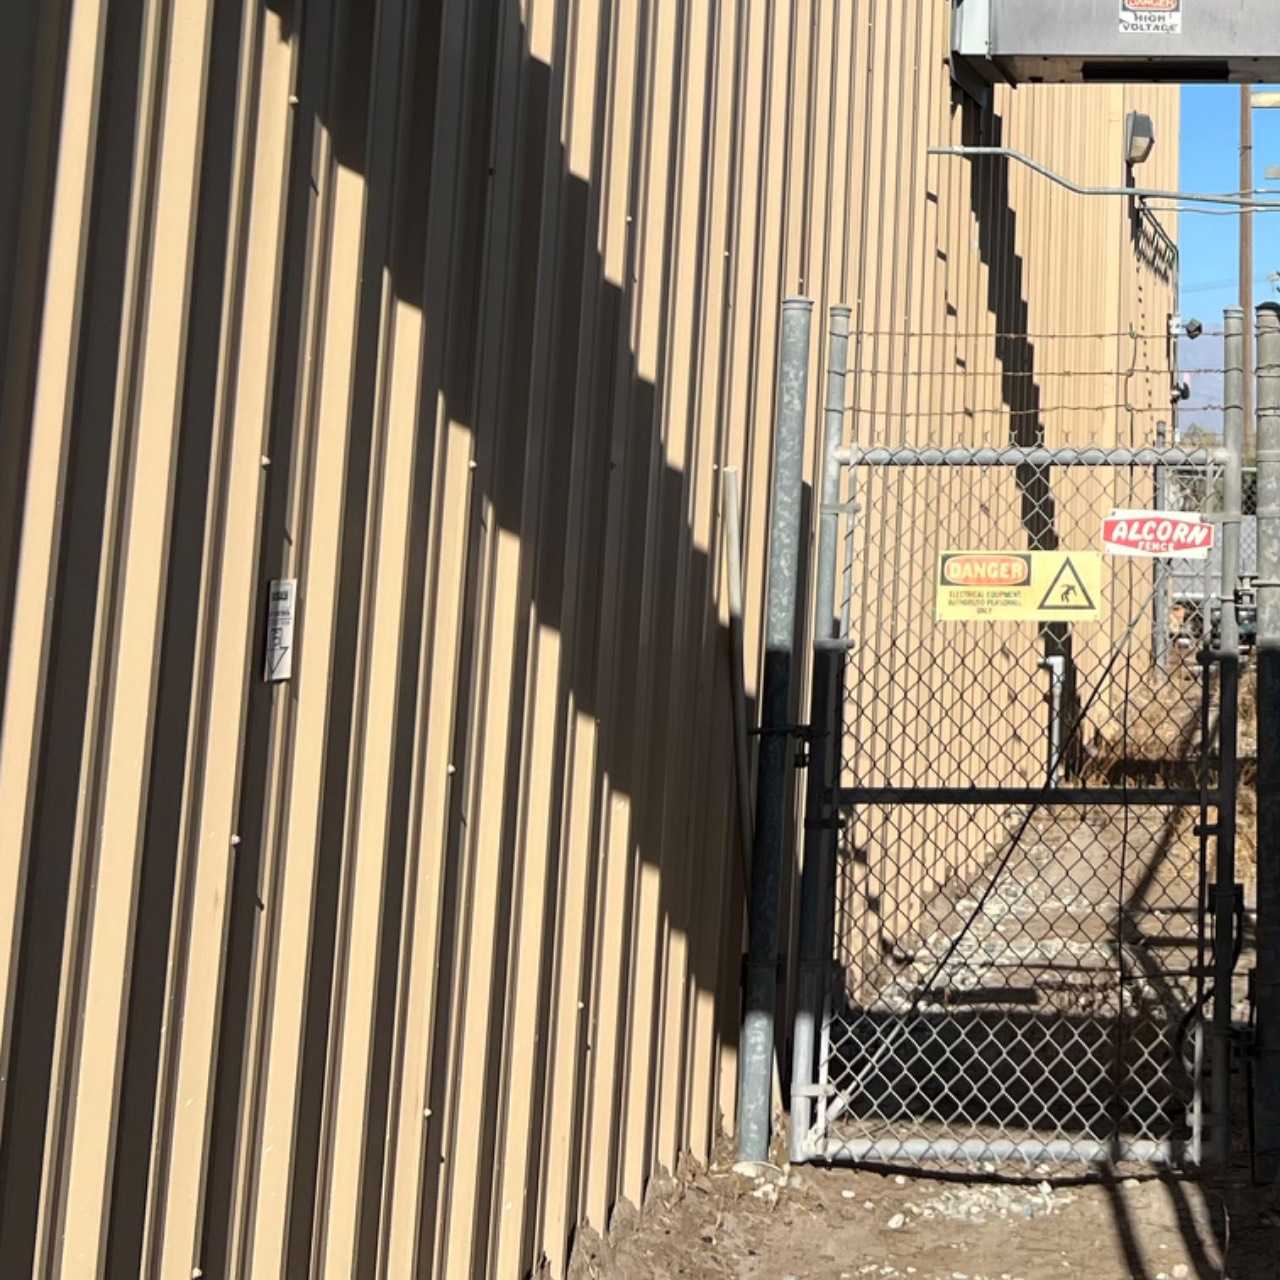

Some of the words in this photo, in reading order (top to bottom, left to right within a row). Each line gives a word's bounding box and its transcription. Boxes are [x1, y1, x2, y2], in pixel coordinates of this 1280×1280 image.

[1133, 14, 1166, 23] HIGH
[1112, 520, 1208, 545] ALCORN
[1137, 541, 1176, 552] FENCE
[950, 561, 1023, 579] DANGER
